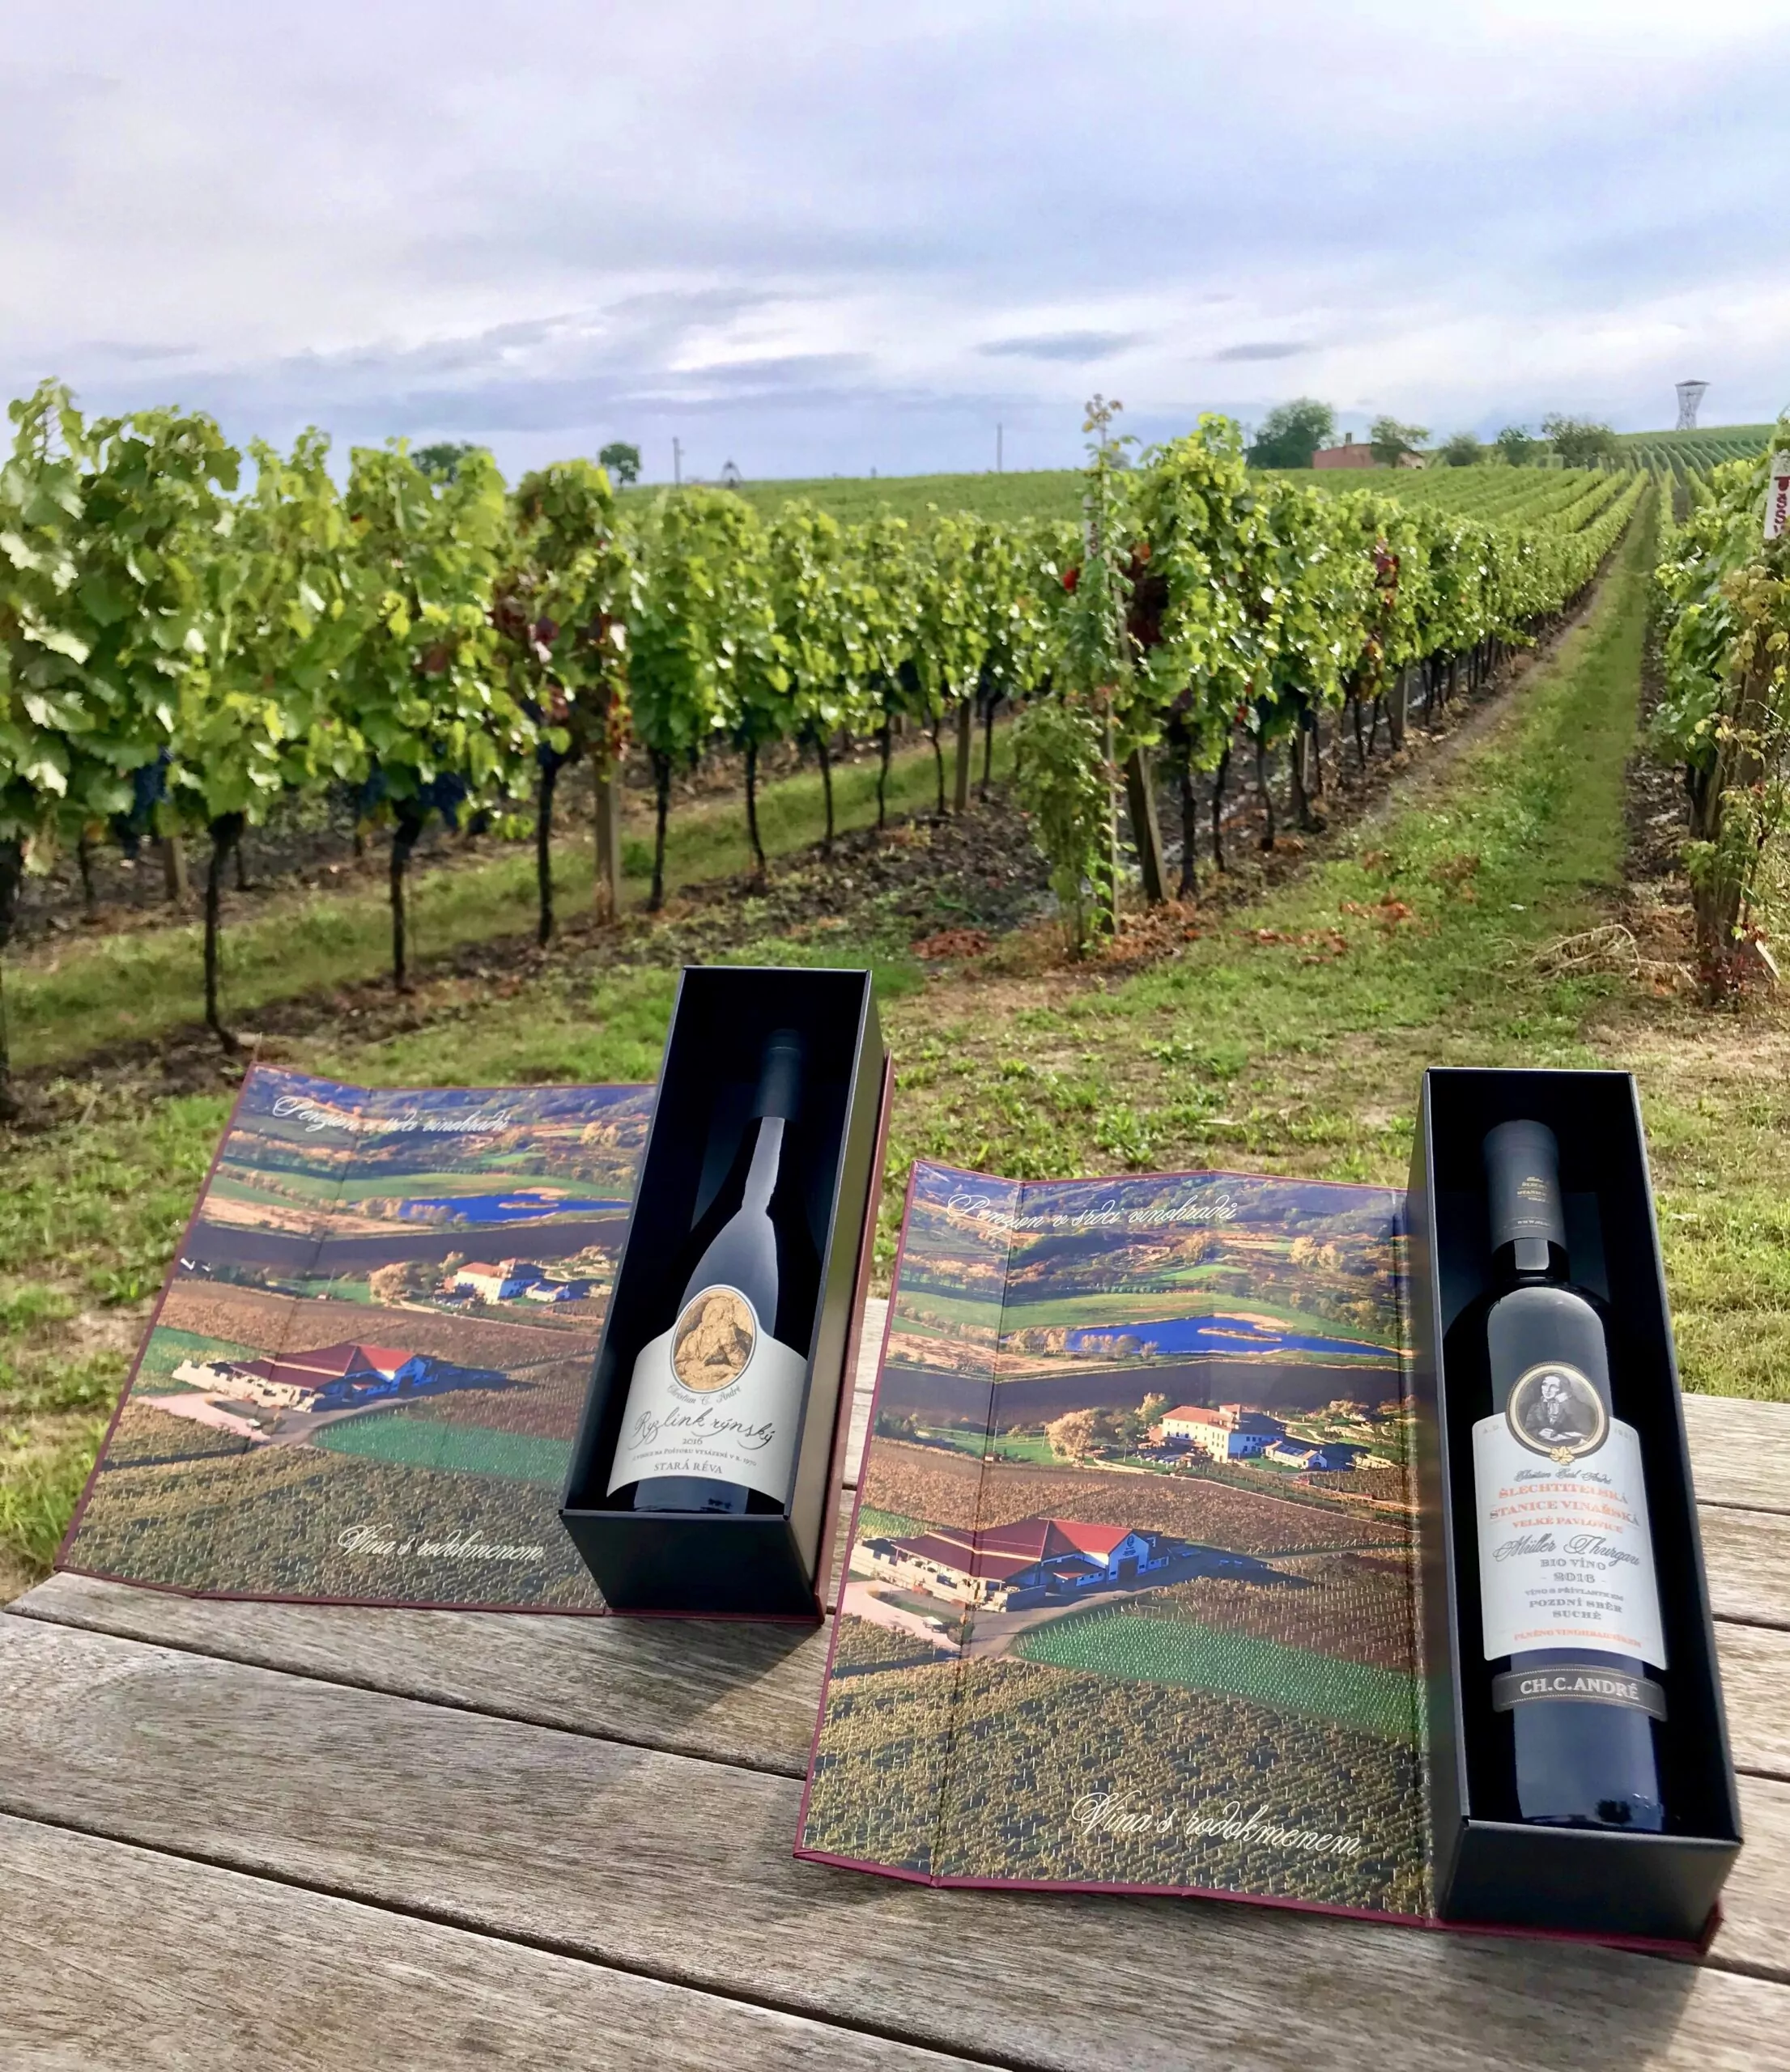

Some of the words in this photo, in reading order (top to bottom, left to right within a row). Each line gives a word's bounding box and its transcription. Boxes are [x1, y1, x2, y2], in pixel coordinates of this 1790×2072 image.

[946, 1194, 1044, 1236] Penzion
[1052, 1214, 1068, 1226] v
[1072, 1199, 1123, 1225] srdci
[1128, 1194, 1238, 1224] vinohradů
[716, 1385, 742, 1403] André
[627, 1407, 714, 1450] Ryzlink
[691, 1418, 776, 1450] rýnský
[682, 1437, 703, 1446] 2016
[654, 1459, 689, 1471] STARÁ
[693, 1460, 723, 1474] RÉVA
[1490, 1501, 1558, 1520] STANICE
[1512, 1515, 1555, 1529] VELKÉ
[1556, 1517, 1624, 1534] PAVLOVICE
[417, 1529, 546, 1561] rodokmenem
[1492, 1533, 1557, 1562] Müller
[1563, 1534, 1641, 1567] Thurgau
[1540, 1558, 1567, 1568] BIO
[1569, 1557, 1606, 1571] VÍNO
[1529, 1597, 1583, 1608] POZDNÍ
[1156, 1808, 1177, 1833] s
[1185, 1800, 1363, 1856] rodokmenem
